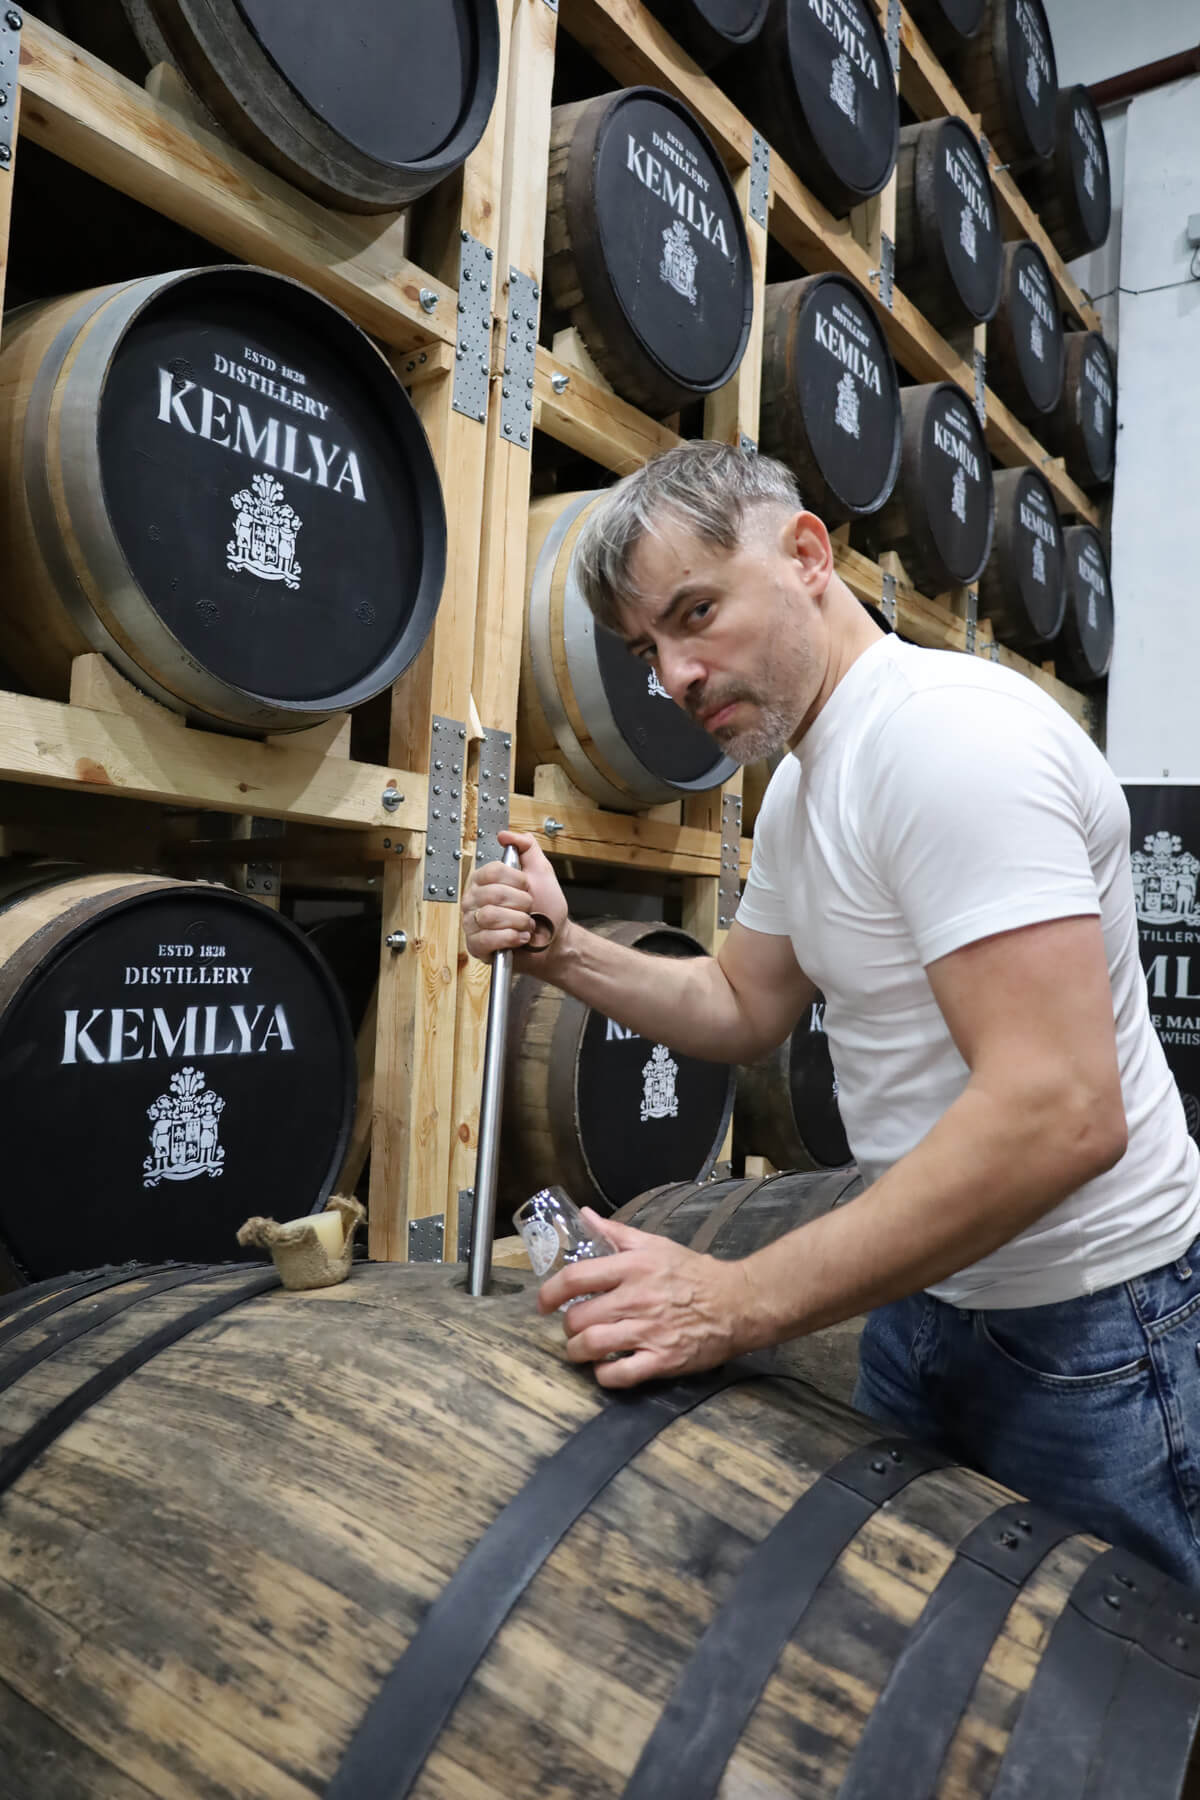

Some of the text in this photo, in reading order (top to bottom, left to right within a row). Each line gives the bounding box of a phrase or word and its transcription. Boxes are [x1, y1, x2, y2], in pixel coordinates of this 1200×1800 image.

[652, 131, 710, 192] DISTILLERY
[945, 148, 990, 232] KEMLYA
[627, 133, 729, 257] KEMLYA
[244, 347, 276, 372] ESTD
[815, 311, 882, 396] KEMLYA
[213, 353, 328, 421] DISTILLERY
[157, 367, 367, 502] KEMLYA
[934, 420, 981, 483] KEMLYA
[124, 966, 253, 985] DISTILLERY
[158, 944, 226, 958] ESTD 1828
[60, 1003, 295, 1065] KEMLYA
